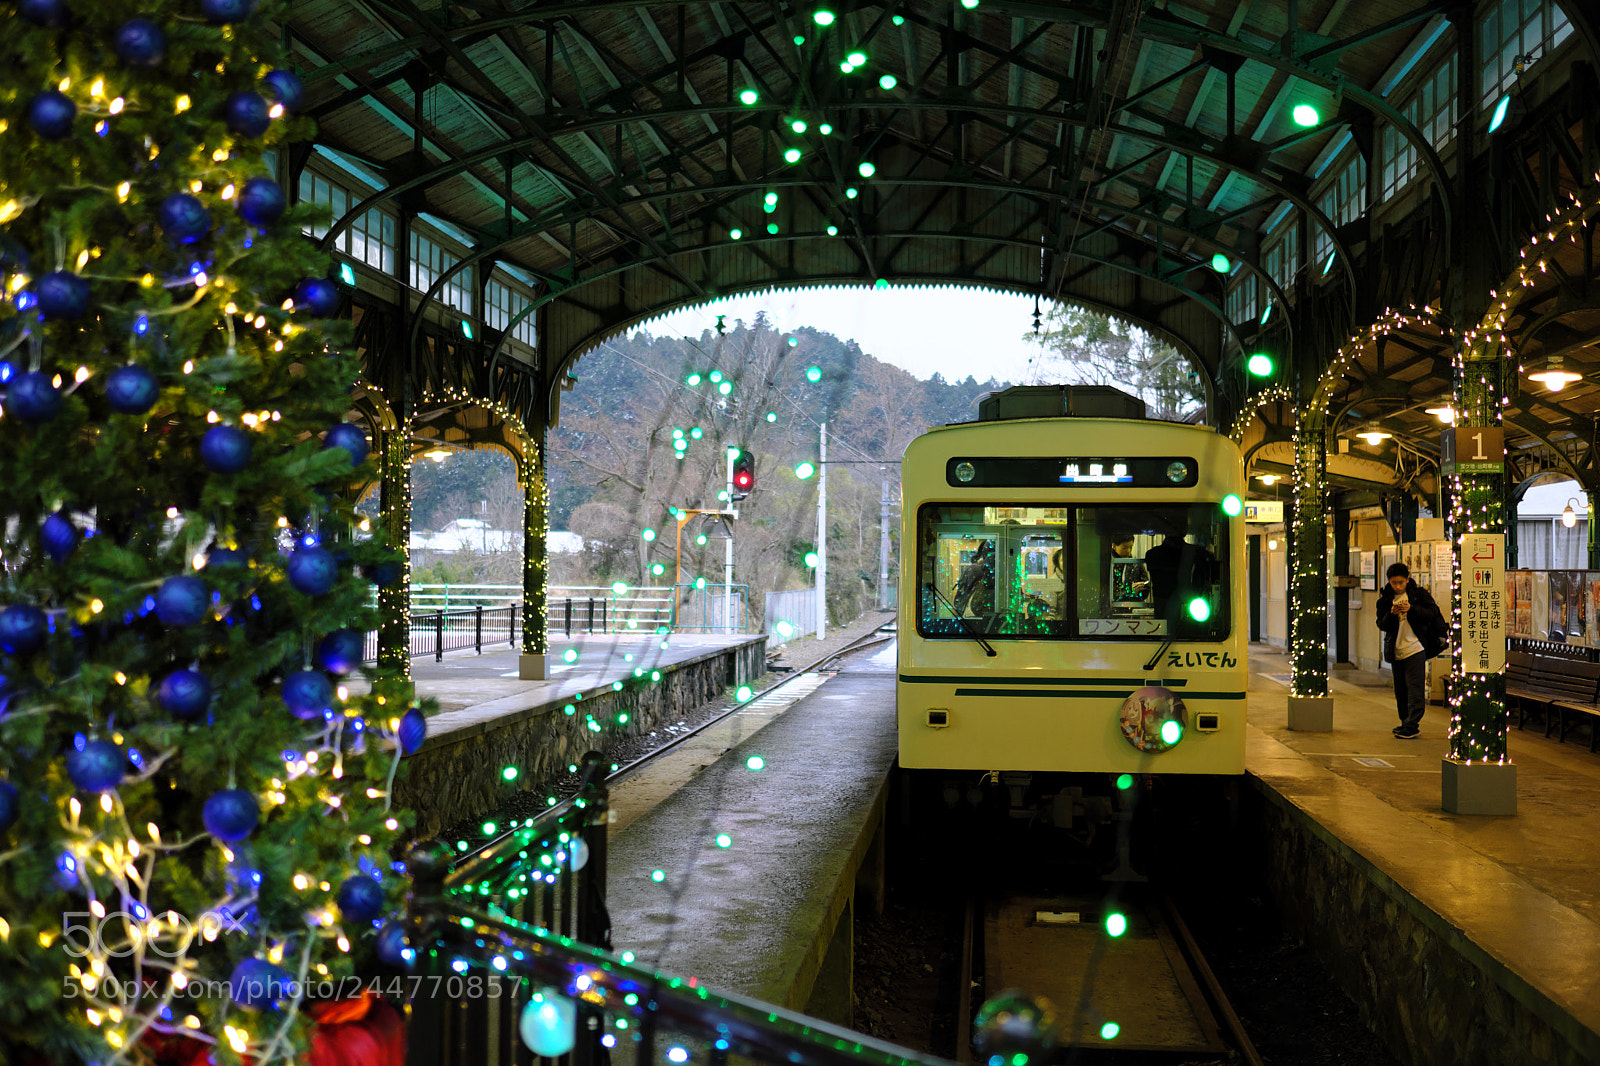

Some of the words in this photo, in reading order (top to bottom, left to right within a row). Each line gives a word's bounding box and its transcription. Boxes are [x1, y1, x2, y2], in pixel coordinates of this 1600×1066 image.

[1445, 435, 1451, 463] 1
[1471, 432, 1488, 460] 1
[1467, 590, 1478, 644] にあります。
[1490, 590, 1501, 630] お手洗は
[1085, 620, 1161, 634] ワンマン
[1478, 590, 1489, 670] 改札口を出て右側
[1167, 651, 1237, 668] えいでん
